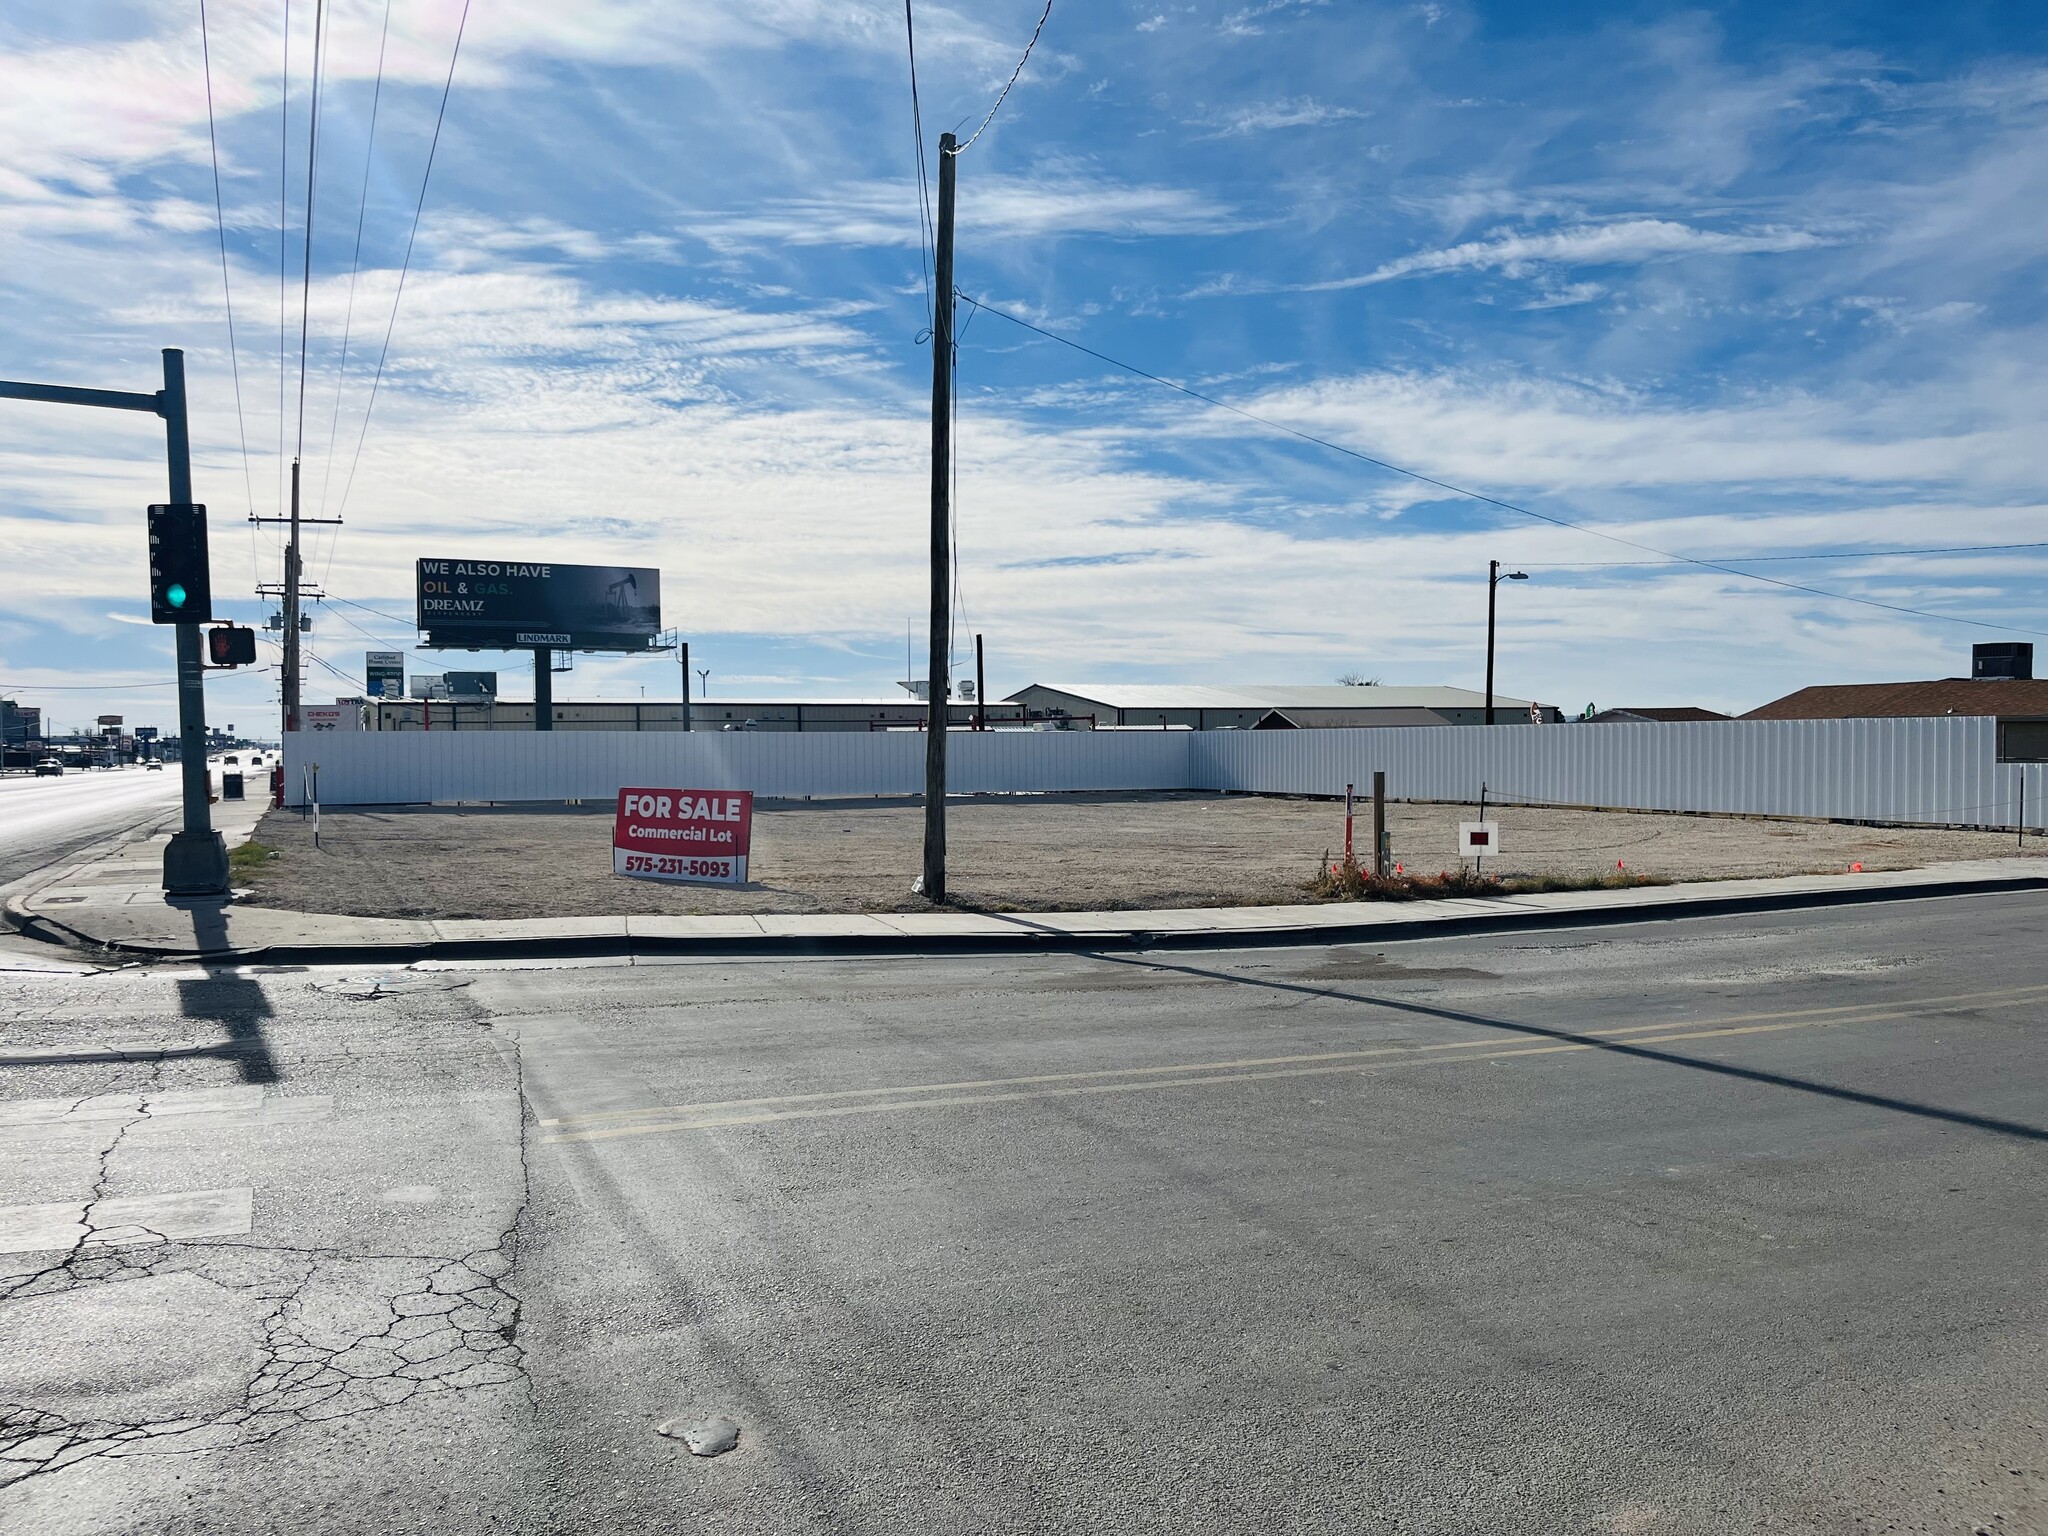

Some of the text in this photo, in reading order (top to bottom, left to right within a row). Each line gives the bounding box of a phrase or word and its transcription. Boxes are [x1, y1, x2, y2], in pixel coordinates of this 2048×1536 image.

[422, 562, 551, 578] WE ALSO HAVE
[423, 581, 513, 595] OIL & GAS.
[423, 599, 485, 612] DREAMZ
[517, 634, 570, 643] LINDMARK
[624, 794, 741, 822] FOR SALE
[628, 824, 732, 843] Commercial Lot
[625, 855, 730, 878] 575-231-5093
